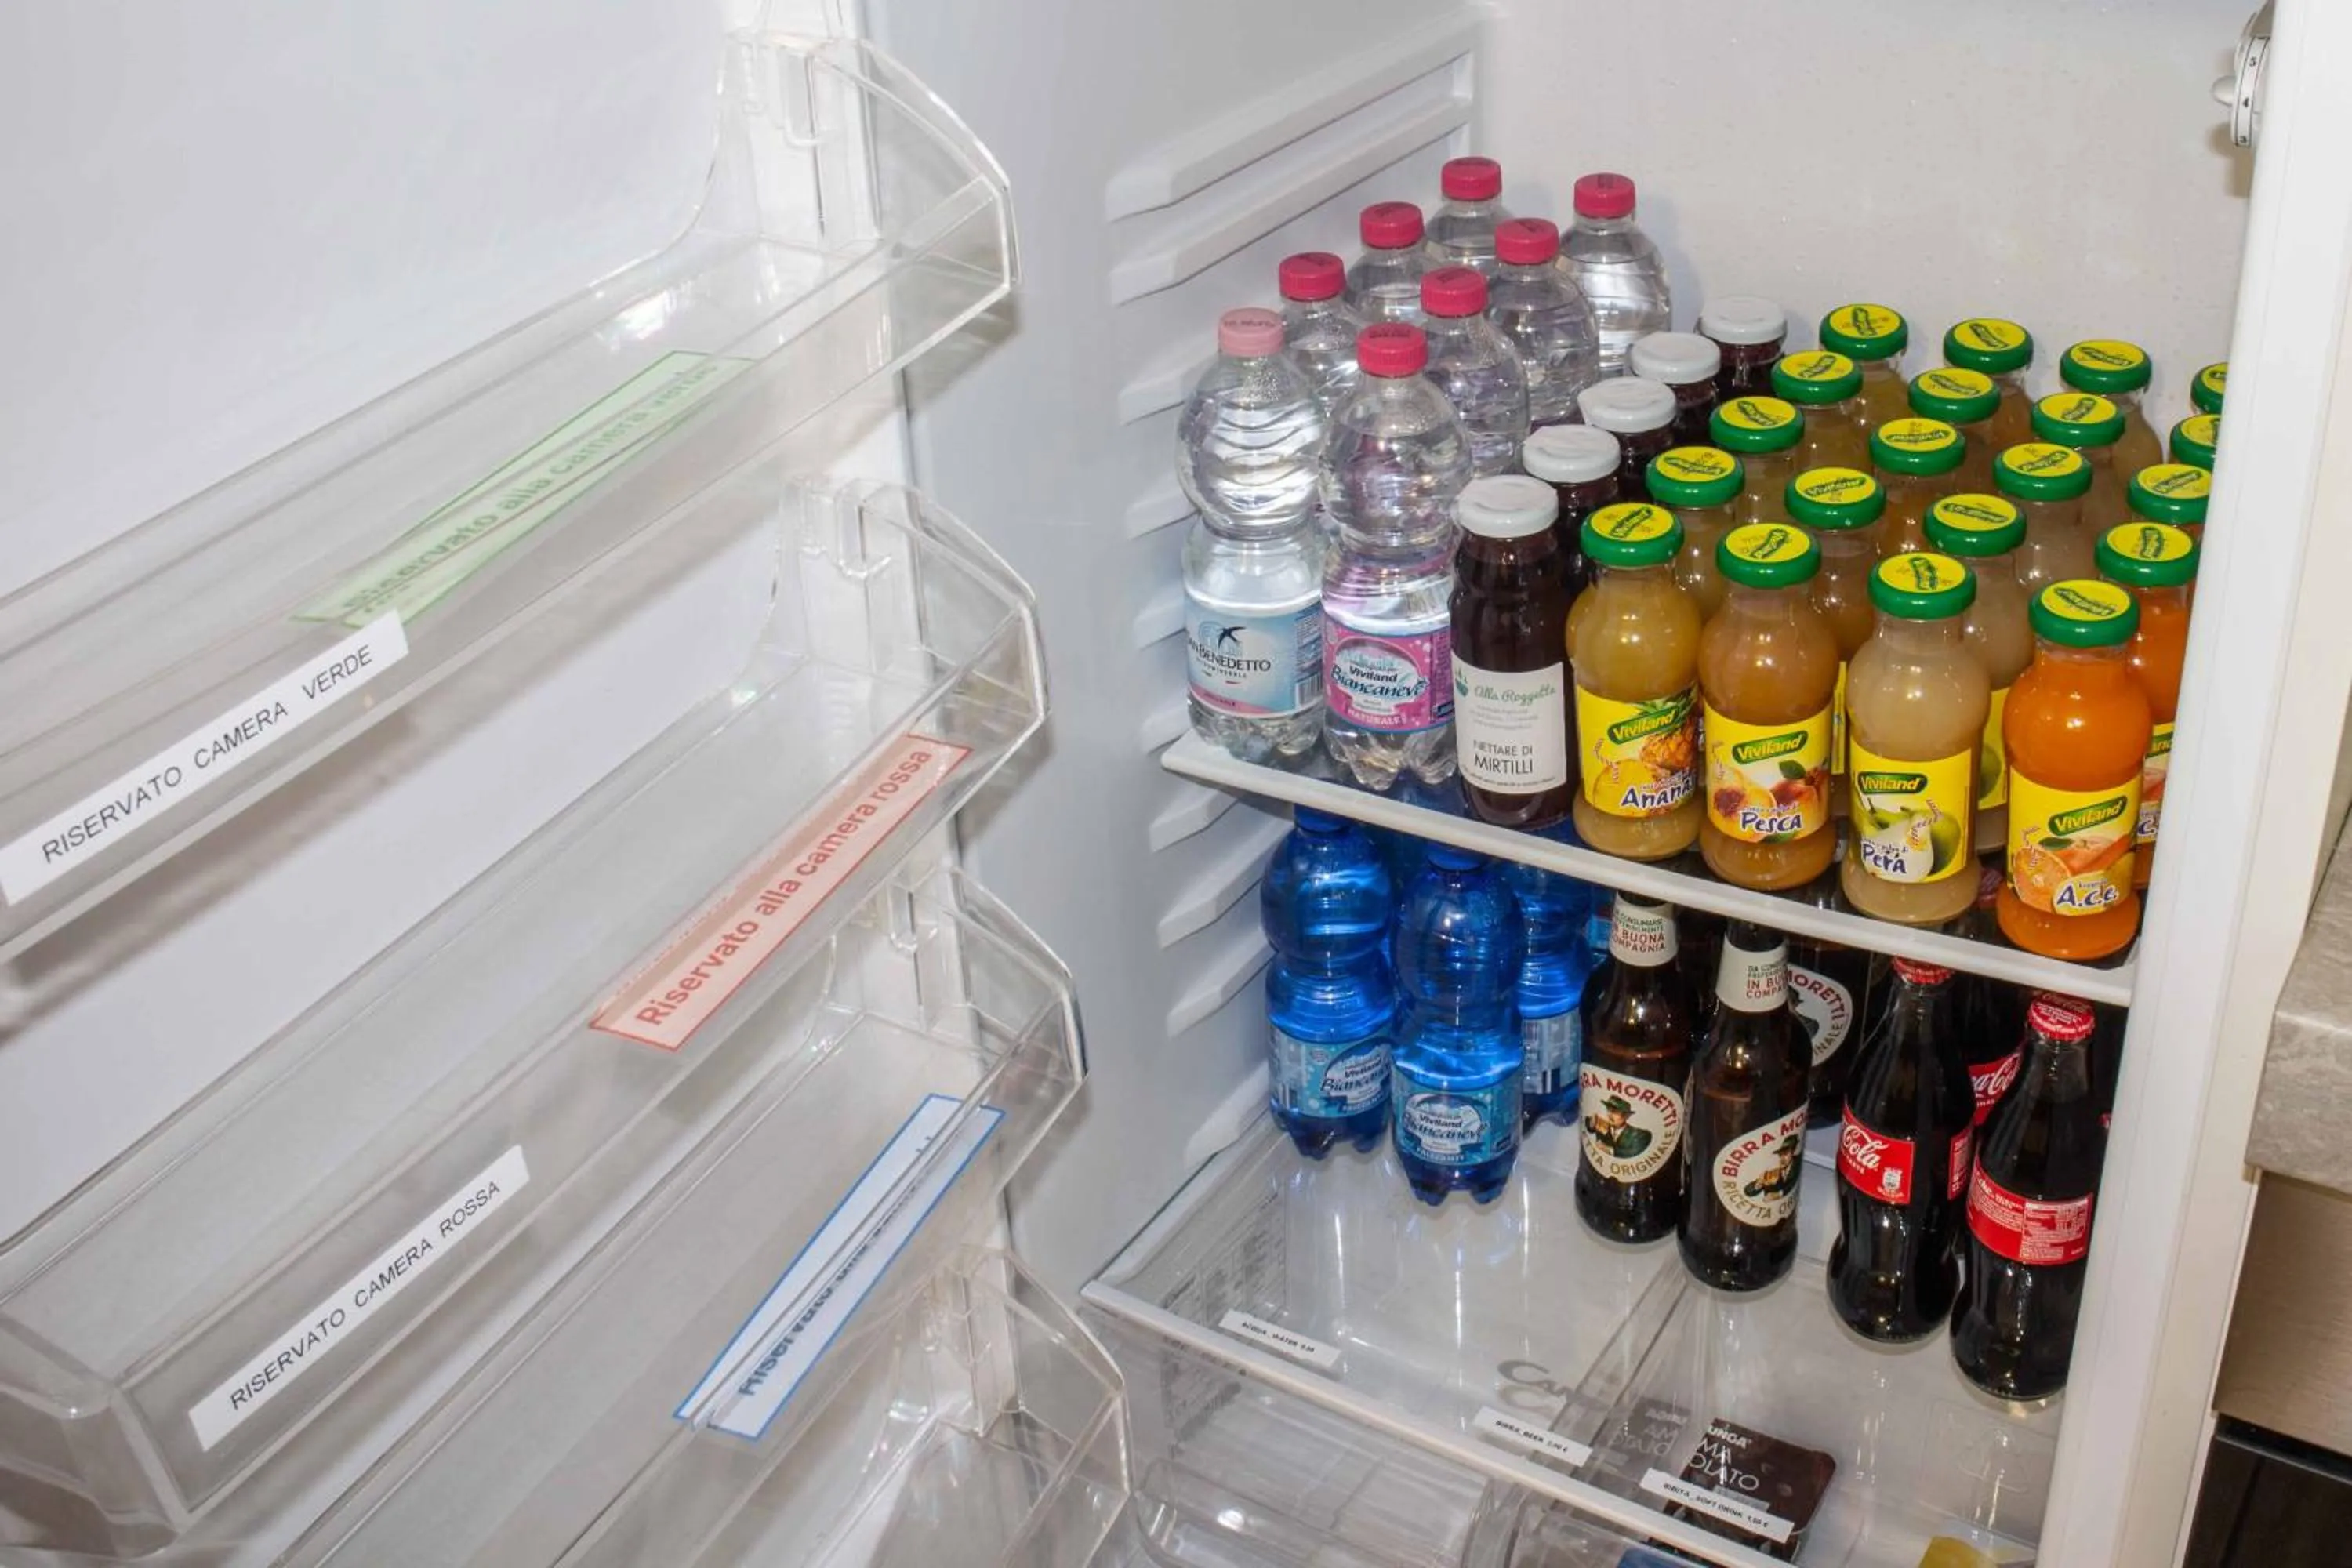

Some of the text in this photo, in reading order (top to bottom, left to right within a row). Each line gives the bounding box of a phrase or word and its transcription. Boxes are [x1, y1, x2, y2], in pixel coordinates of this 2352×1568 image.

[2249, 56, 2256, 67] 5
[2242, 97, 2249, 107] 4
[1198, 643, 1272, 673] BENEDETTO
[1348, 665, 1398, 683] Viviland
[1613, 710, 1675, 739] Viviland
[42, 644, 374, 863] RISERVATO CAMERA VERDE
[1472, 739, 1534, 757] NETTARE DI
[1737, 733, 1802, 761] Viviland
[1474, 753, 1534, 775] MIRTILLI
[1621, 776, 1695, 808] Anana
[1860, 776, 1920, 791] Viviland
[2053, 799, 2124, 833] Viviland
[636, 749, 933, 1025] Riservato alla camera rossa
[1622, 929, 1664, 943] BUONA
[1746, 979, 1760, 990] IN
[1606, 1078, 1678, 1128] MORETTI
[1419, 1113, 1463, 1129] Viviland
[1610, 1129, 1675, 1176] ORIGINALE
[1721, 1131, 1777, 1178] BIRRA
[1722, 1180, 1772, 1218] RICETTA
[229, 1180, 501, 1411] RISERVATO CAMERA ROSSA
[1718, 1504, 1743, 1518] DRINK
